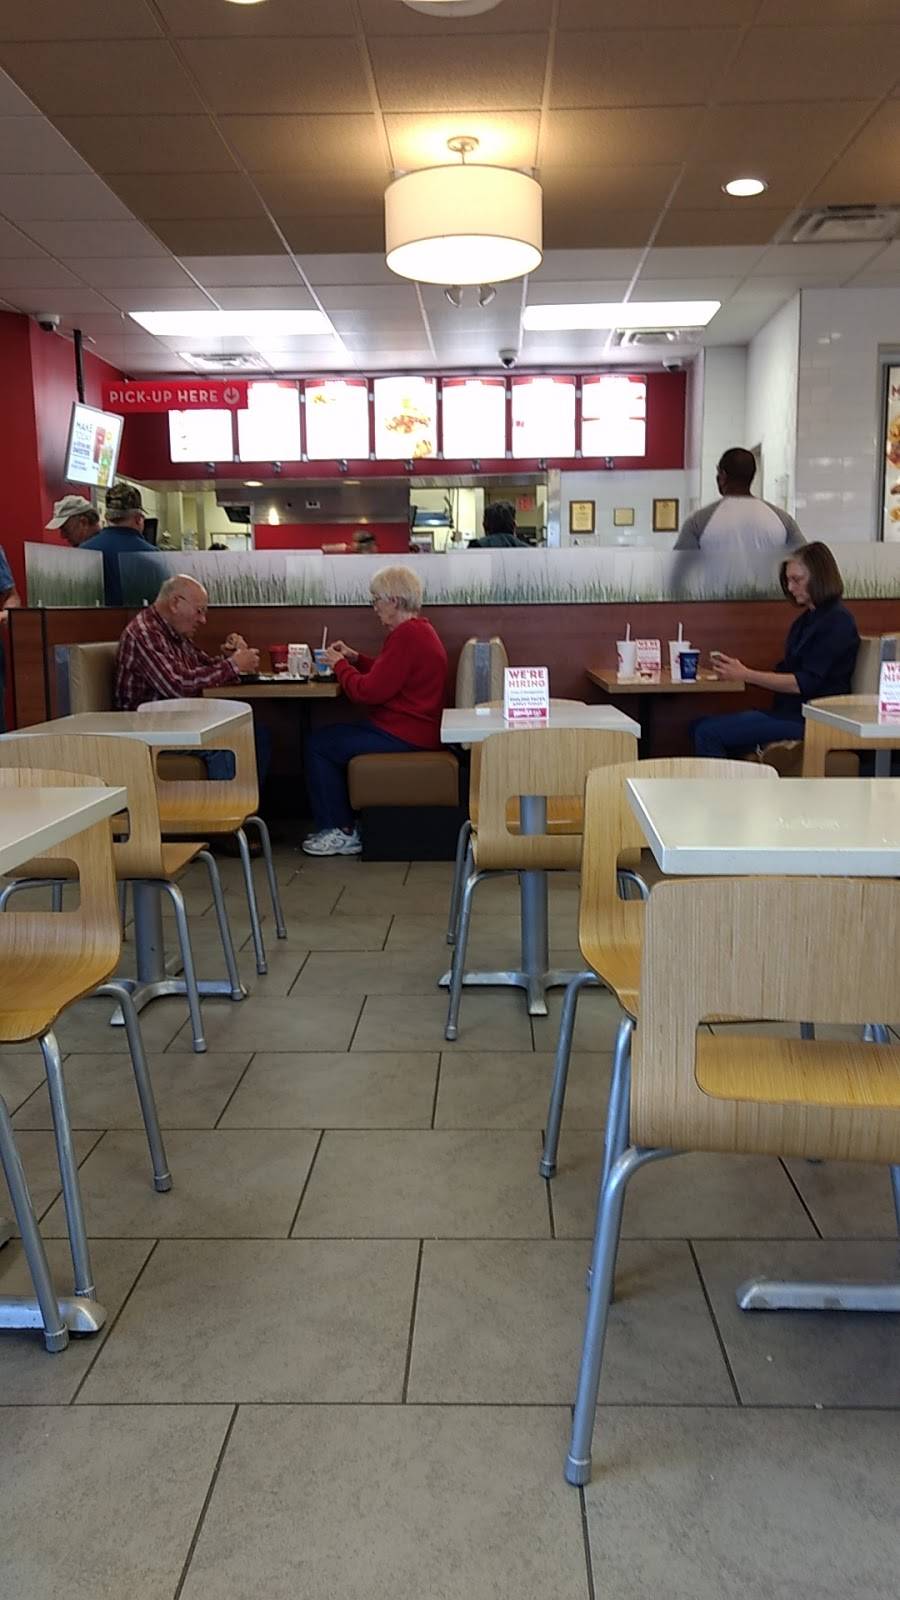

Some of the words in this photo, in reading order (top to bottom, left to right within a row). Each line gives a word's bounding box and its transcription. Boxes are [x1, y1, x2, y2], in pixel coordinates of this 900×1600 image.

[109, 390, 172, 403] PICK-UP
[177, 389, 218, 403] HERE
[509, 670, 544, 679] WE'RE
[508, 680, 545, 688] HIRING
